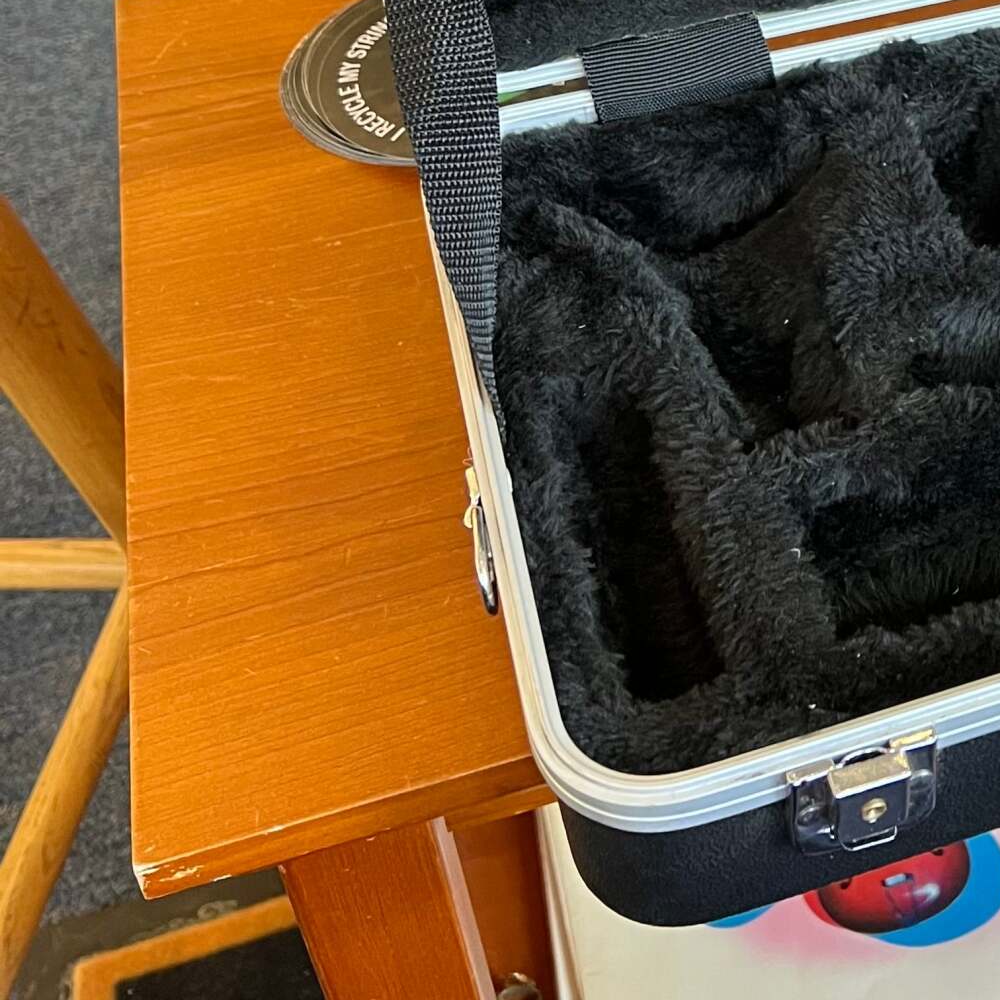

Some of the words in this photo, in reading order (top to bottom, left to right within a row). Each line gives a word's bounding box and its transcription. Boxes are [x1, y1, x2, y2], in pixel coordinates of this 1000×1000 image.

[346, 16, 388, 59] STRIN
[337, 61, 361, 83] MY
[338, 83, 395, 138] RECYCLE
[390, 126, 406, 141] I
